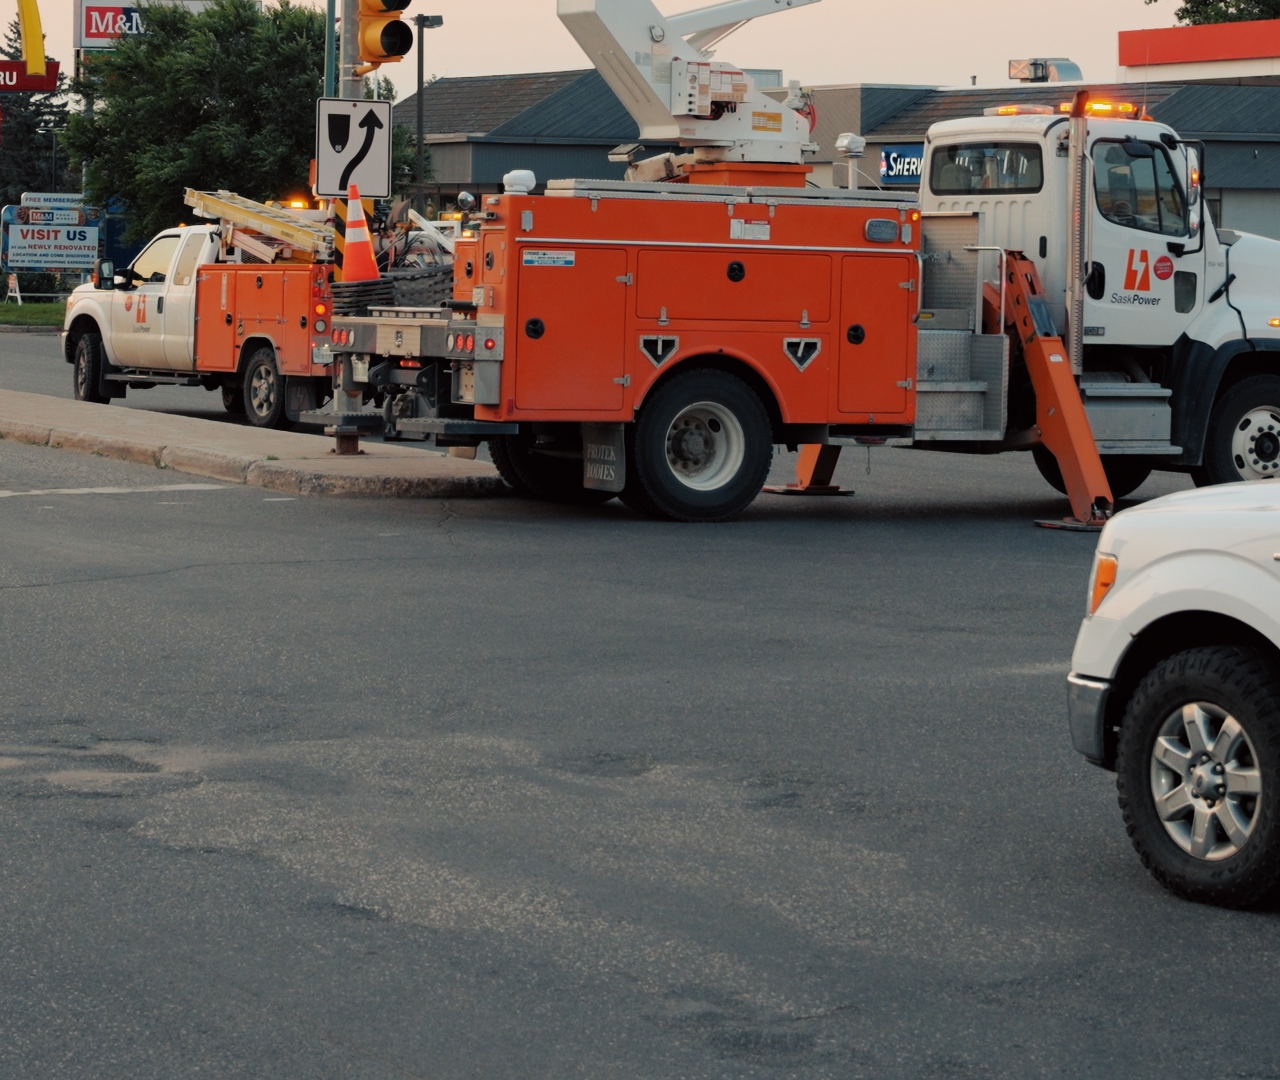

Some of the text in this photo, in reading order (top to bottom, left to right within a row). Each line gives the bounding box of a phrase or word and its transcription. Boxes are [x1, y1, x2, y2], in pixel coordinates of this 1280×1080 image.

[20, 229, 87, 241] VISIT US
[1110, 292, 1161, 306] SaskPower
